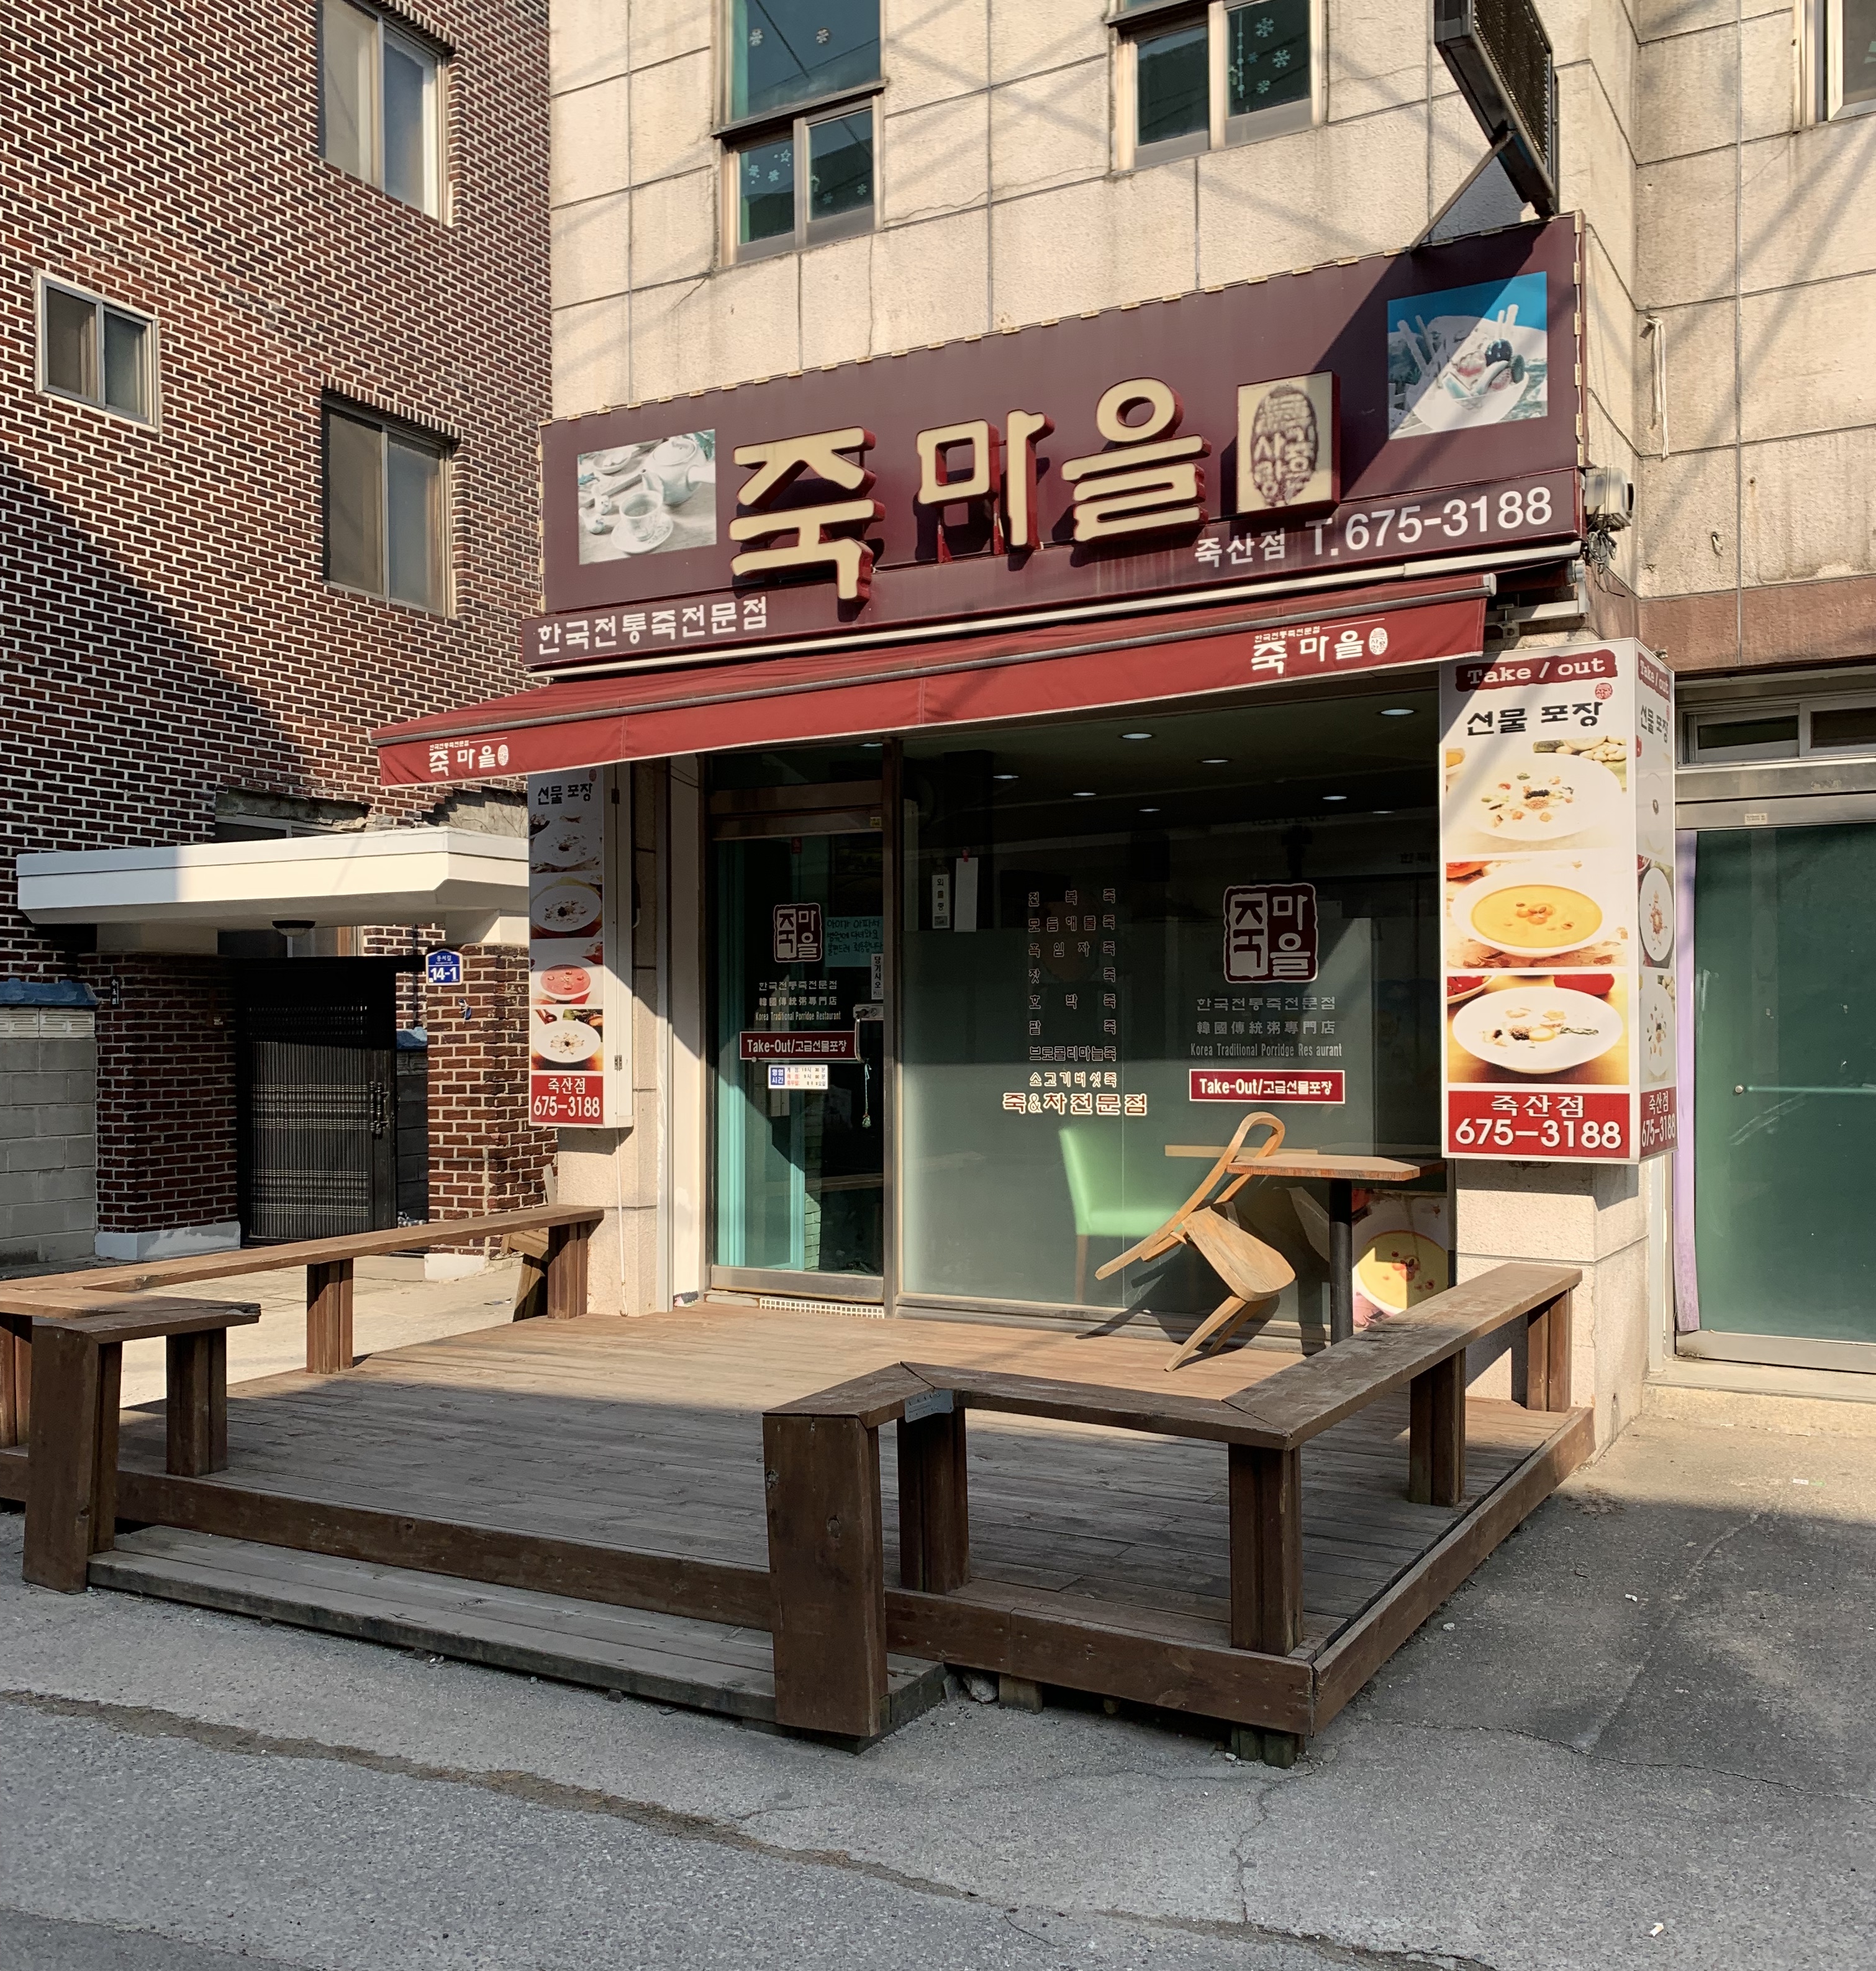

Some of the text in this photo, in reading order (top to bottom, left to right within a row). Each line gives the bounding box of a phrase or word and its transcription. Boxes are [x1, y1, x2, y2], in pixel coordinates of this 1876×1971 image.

[1195, 528, 1286, 568] 죽산점
[537, 596, 768, 655] 한국전통죽전문점
[1254, 626, 1320, 643] 한국전통죽전문점
[1467, 666, 1531, 684] Take
[1557, 658, 1605, 676] out
[1639, 659, 1655, 684] Take
[1659, 677, 1669, 694] out
[1467, 702, 1603, 736] 선물 포장
[1641, 704, 1669, 743] 선물 포장
[538, 783, 593, 805] 선물 포장
[430, 967, 457, 981] 14-1
[759, 981, 837, 991] 한국전통죽전문점
[755, 1010, 841, 1021] Korea Traditional Porridge Restaurant
[1197, 996, 1336, 1012] 한국전통죽전문점
[1030, 1046, 1117, 1061] 브로콜리마늘죽
[1190, 1043, 1213, 1056] Korea
[1217, 1043, 1258, 1056] Traditional
[1261, 1043, 1295, 1057] Porridge
[548, 1077, 586, 1094] 죽산점
[1029, 1071, 1117, 1088] 소고기버섯죽
[533, 1095, 600, 1118] 675-3188
[1490, 1094, 1584, 1117] 죽산점
[1648, 1090, 1669, 1115] 죽산점
[1455, 1118, 1622, 1149] 675-3188
[1641, 1113, 1676, 1148] 675-3188
